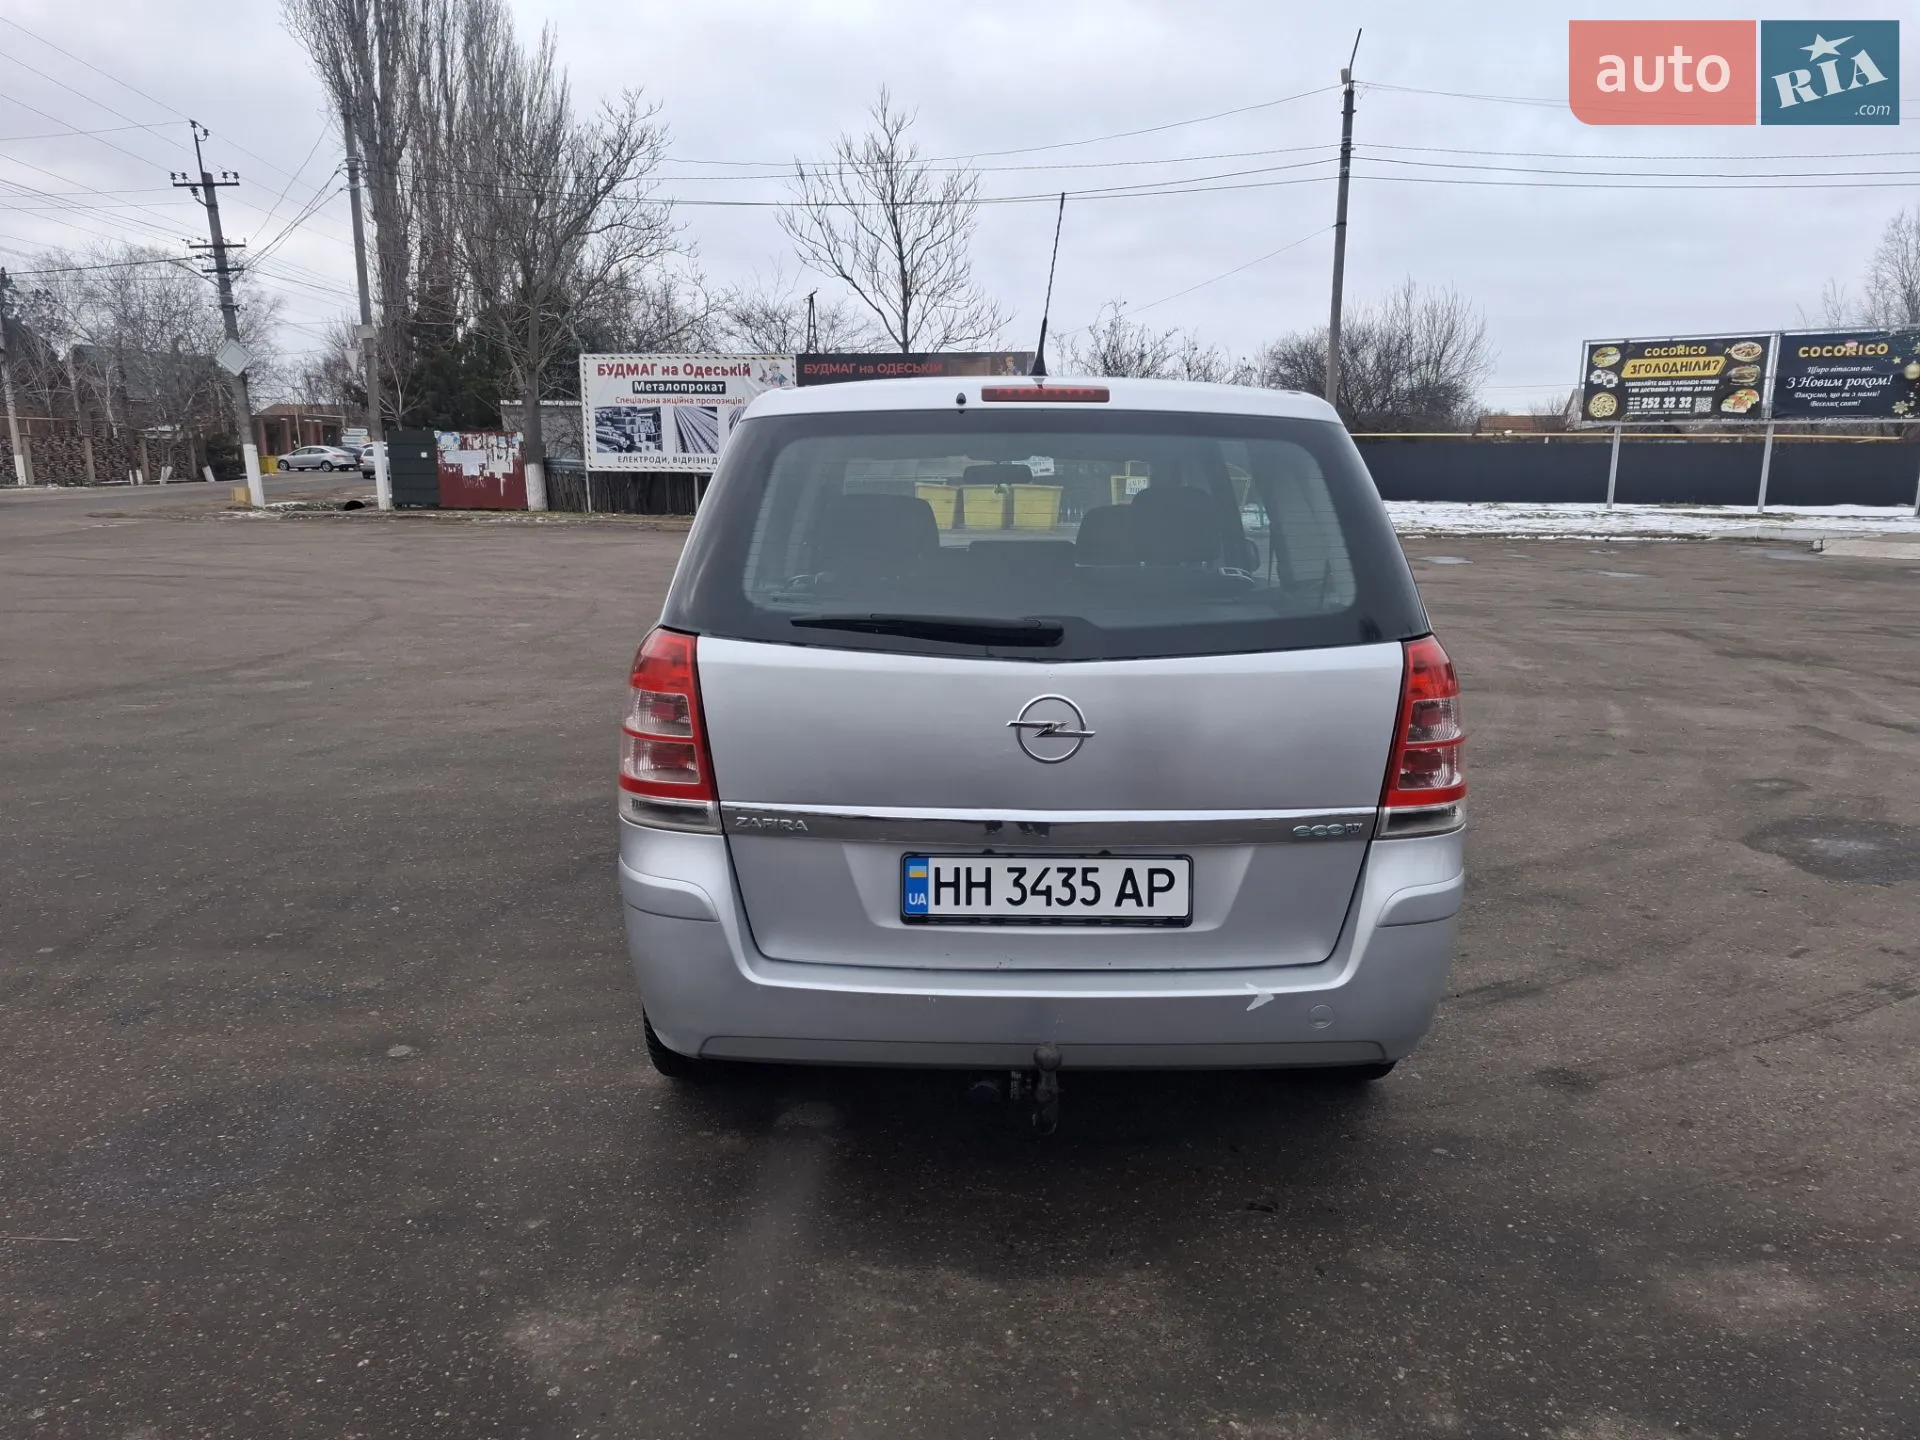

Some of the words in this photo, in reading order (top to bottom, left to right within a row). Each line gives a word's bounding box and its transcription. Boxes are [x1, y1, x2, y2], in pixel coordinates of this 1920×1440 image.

[1644, 344, 1707, 357] COCORICO
[1798, 342, 1889, 358] COCORICO
[597, 363, 657, 378] БУДМАГ
[661, 365, 678, 376] на
[683, 363, 751, 378] Одеській
[803, 363, 856, 376] БУДМАГ
[859, 365, 874, 375] на
[877, 361, 943, 376] ОДЕСЬКІЙ
[1630, 360, 1720, 375] ЗГОЛОДНІЛИ?
[634, 381, 725, 394] Металопрокат
[1797, 375, 1843, 388] Новим
[1844, 374, 1893, 390] роком!
[615, 396, 661, 405] Спеціальна
[662, 396, 694, 405] акційна
[696, 396, 745, 405] пропозиція!
[1641, 397, 1660, 409] 252
[1663, 397, 1677, 409] 32
[1679, 396, 1692, 409] 32
[618, 456, 670, 465] ЕЛЕКТРОДИ,
[673, 456, 709, 465] ВІДРІЗНІ
[735, 816, 808, 832] ZAFIRA
[934, 866, 991, 906] HH
[1006, 866, 1101, 907] 3435
[1114, 867, 1175, 907] AP
[908, 893, 926, 905] UA
